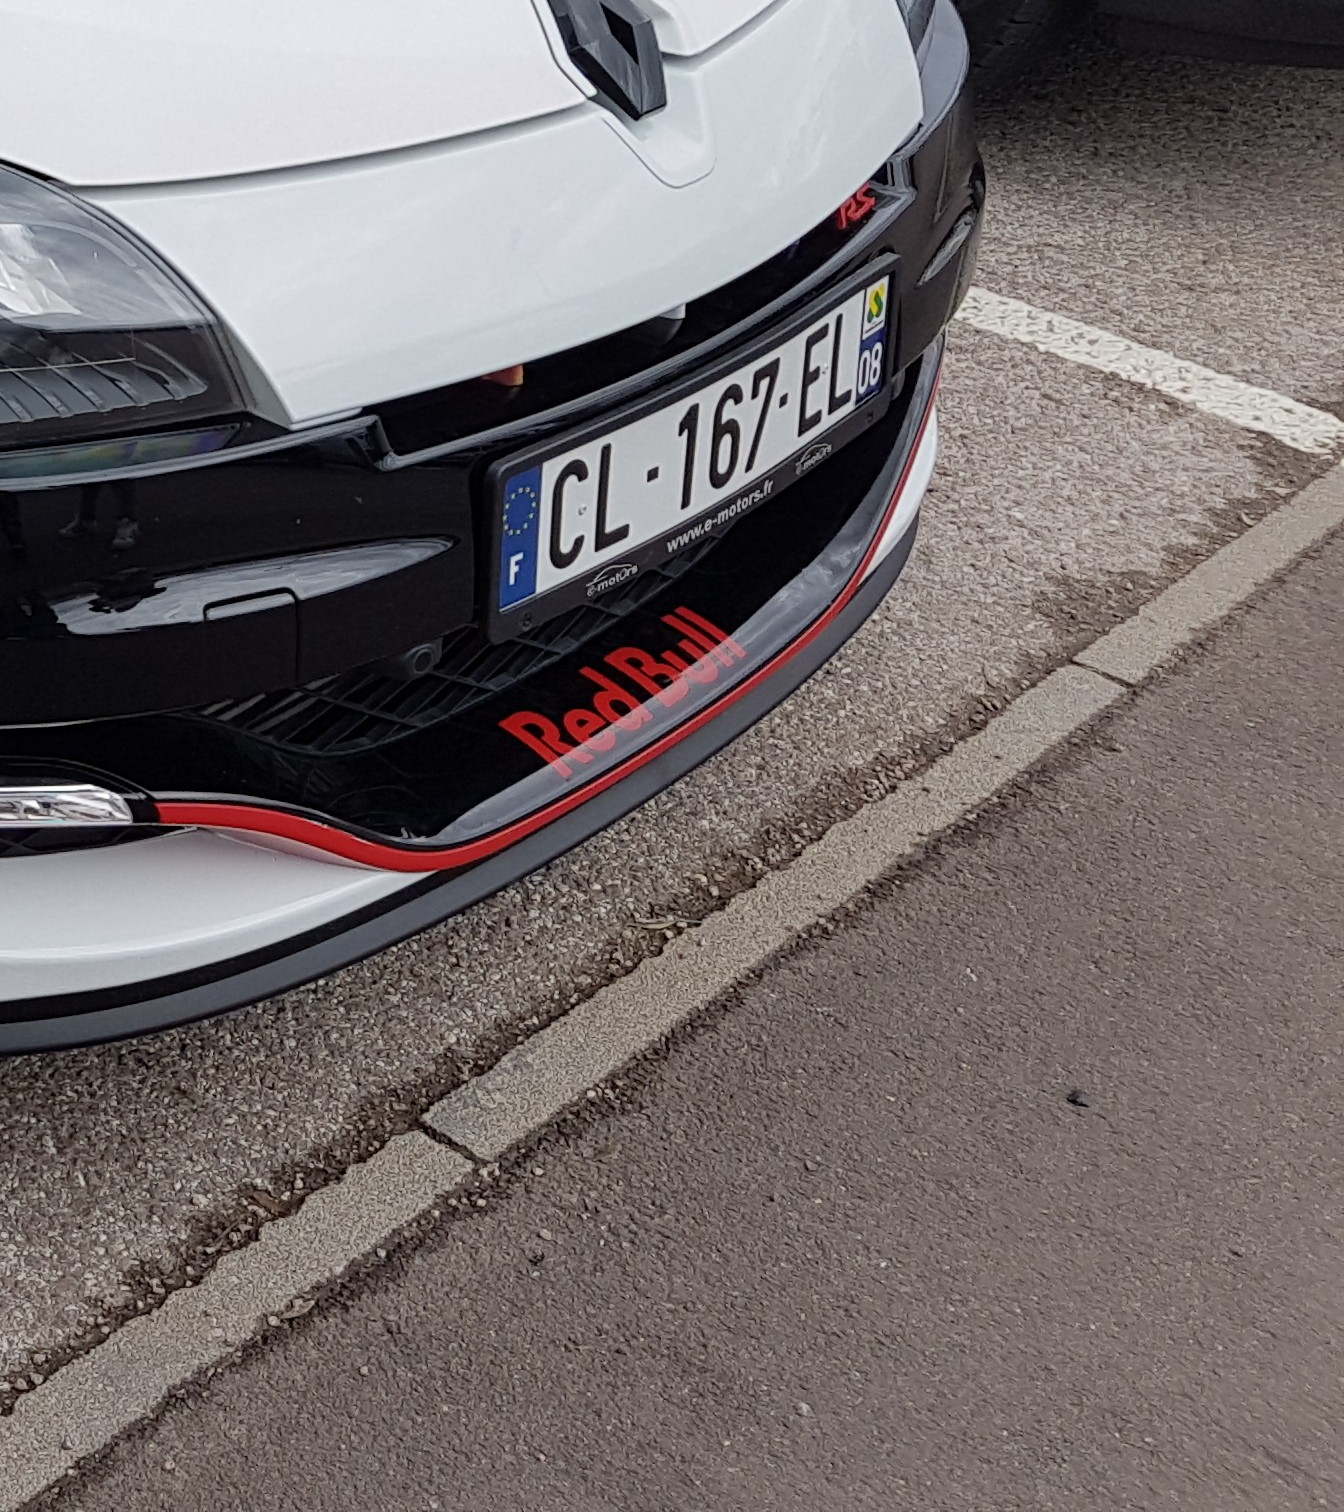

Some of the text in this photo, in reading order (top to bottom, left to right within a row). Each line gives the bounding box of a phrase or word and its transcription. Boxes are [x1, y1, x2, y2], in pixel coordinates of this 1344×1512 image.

[857, 341, 883, 395] 08
[666, 478, 774, 553] www.e-motors.fr
[508, 552, 524, 586] F
[498, 605, 748, 778] Red Bull
